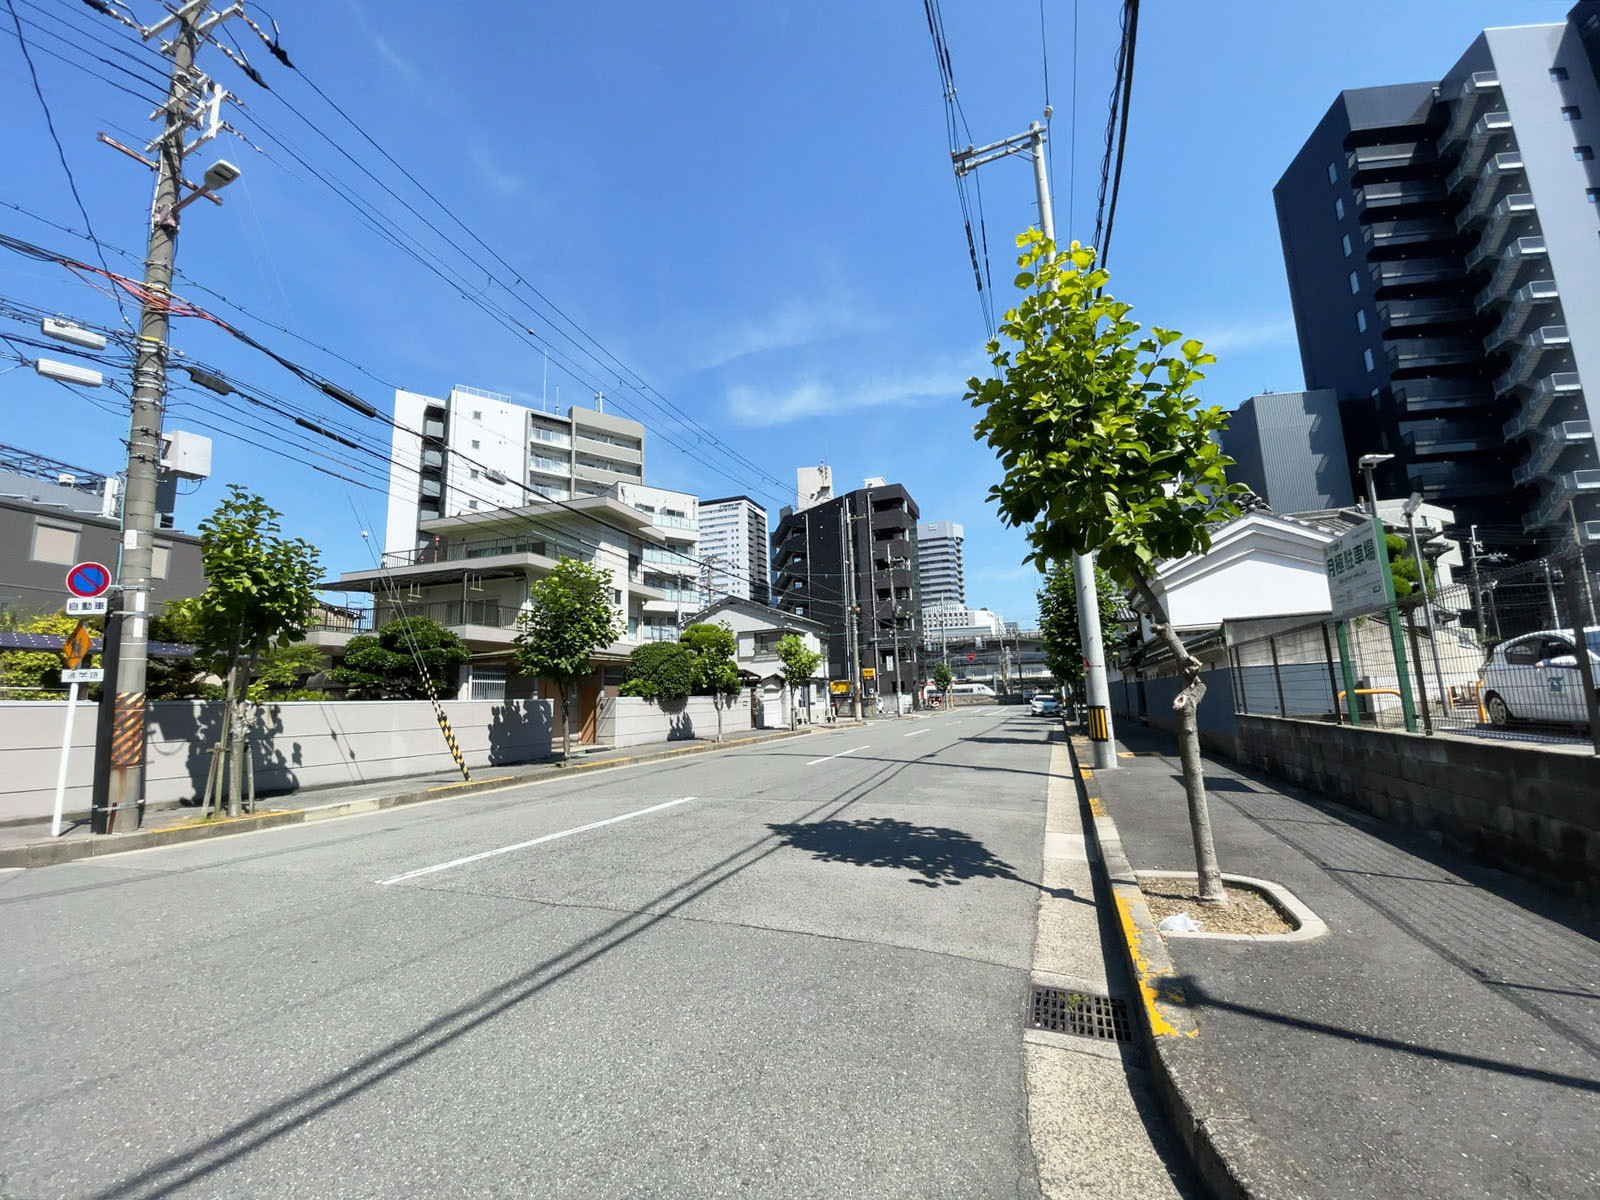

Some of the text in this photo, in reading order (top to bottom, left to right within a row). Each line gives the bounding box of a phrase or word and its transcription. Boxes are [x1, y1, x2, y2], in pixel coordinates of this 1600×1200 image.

[1327, 538, 1376, 577] 月極駐車場
[69, 601, 105, 611] 自動車
